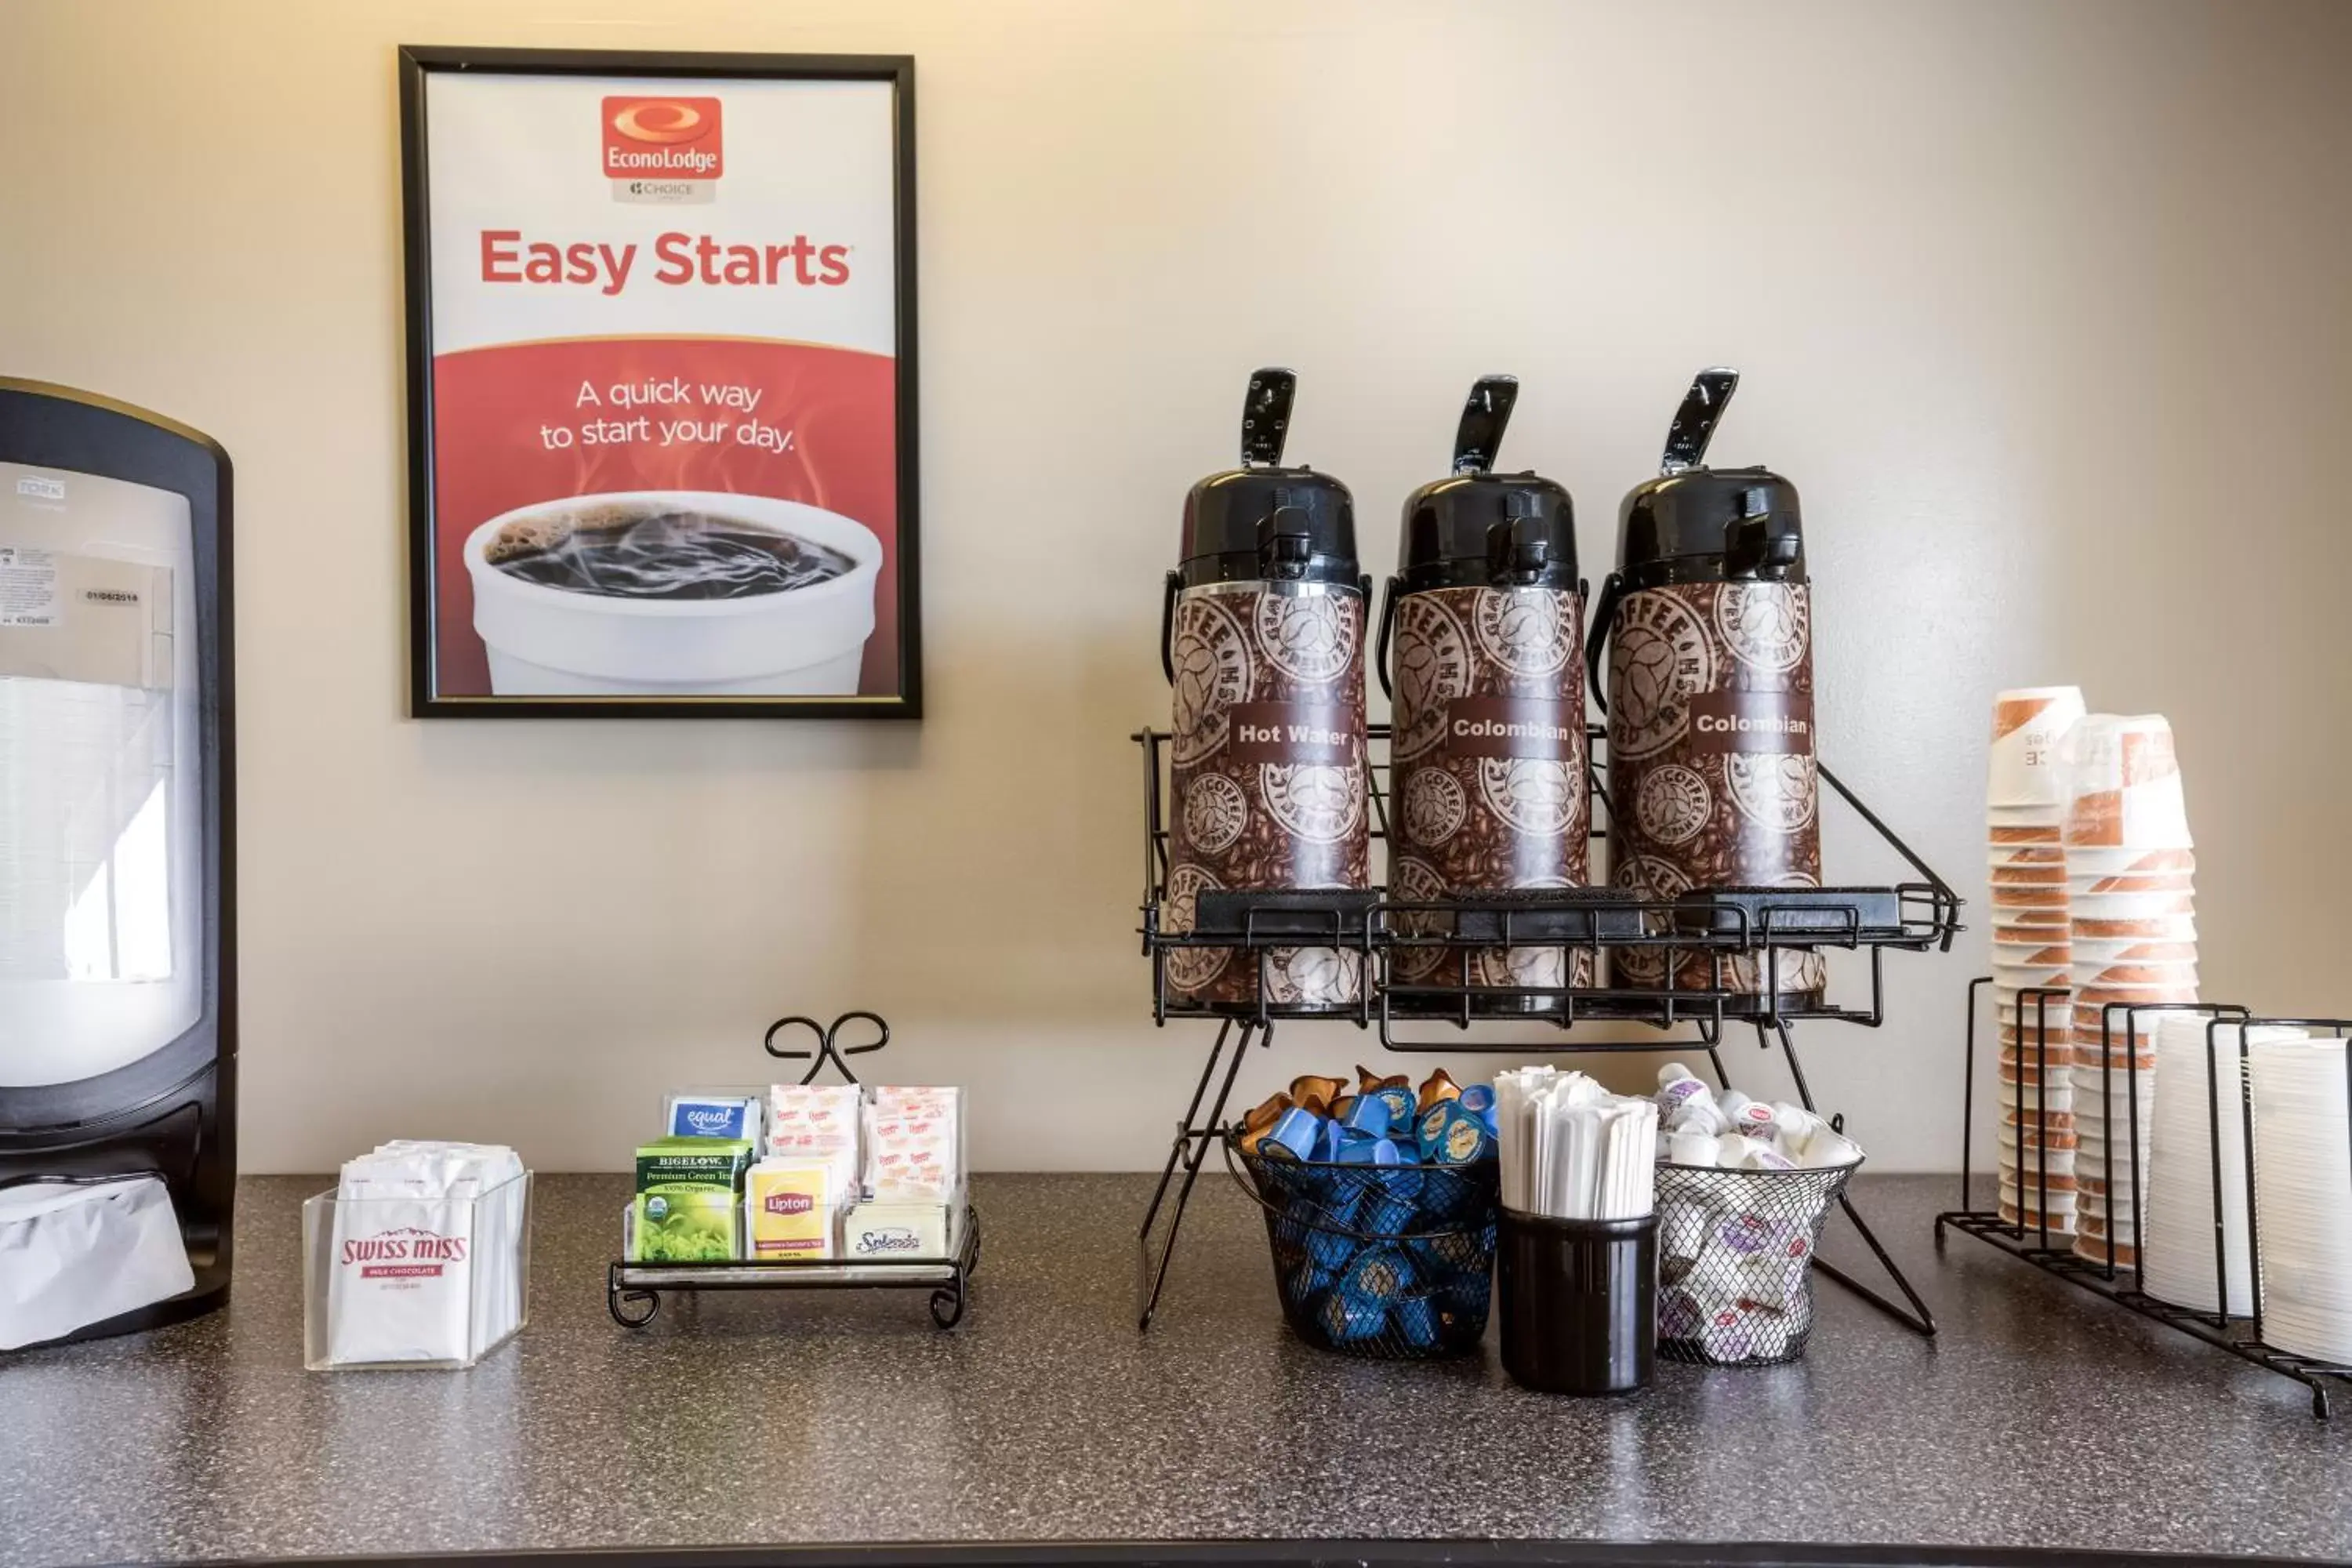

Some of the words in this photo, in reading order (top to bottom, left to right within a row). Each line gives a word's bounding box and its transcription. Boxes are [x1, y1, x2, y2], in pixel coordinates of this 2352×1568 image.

[608, 147, 717, 172] EconoLodge
[644, 183, 692, 194] CHOICE
[481, 230, 637, 296] Easy
[655, 232, 850, 286] Starts
[575, 380, 601, 408] A
[610, 376, 691, 410] quick
[700, 384, 762, 412] way
[541, 424, 573, 449] to
[582, 416, 650, 445] start
[659, 419, 728, 452] your
[736, 420, 795, 453] day.
[1453, 719, 1568, 740] Colombian
[1697, 714, 1807, 734] Colombian
[1239, 724, 1281, 742] Hot
[1287, 724, 1348, 746] Water
[687, 1106, 733, 1127] equal
[659, 1156, 721, 1167] BIGELOW
[647, 1171, 686, 1180] Premium
[688, 1171, 716, 1180] Green
[684, 1185, 716, 1193] Organic
[768, 1198, 811, 1211] Lipton
[341, 1239, 409, 1265] SWISS
[412, 1236, 468, 1262] MISS
[855, 1232, 920, 1254] Splenda
[390, 1266, 436, 1276] CHOCOLATE
